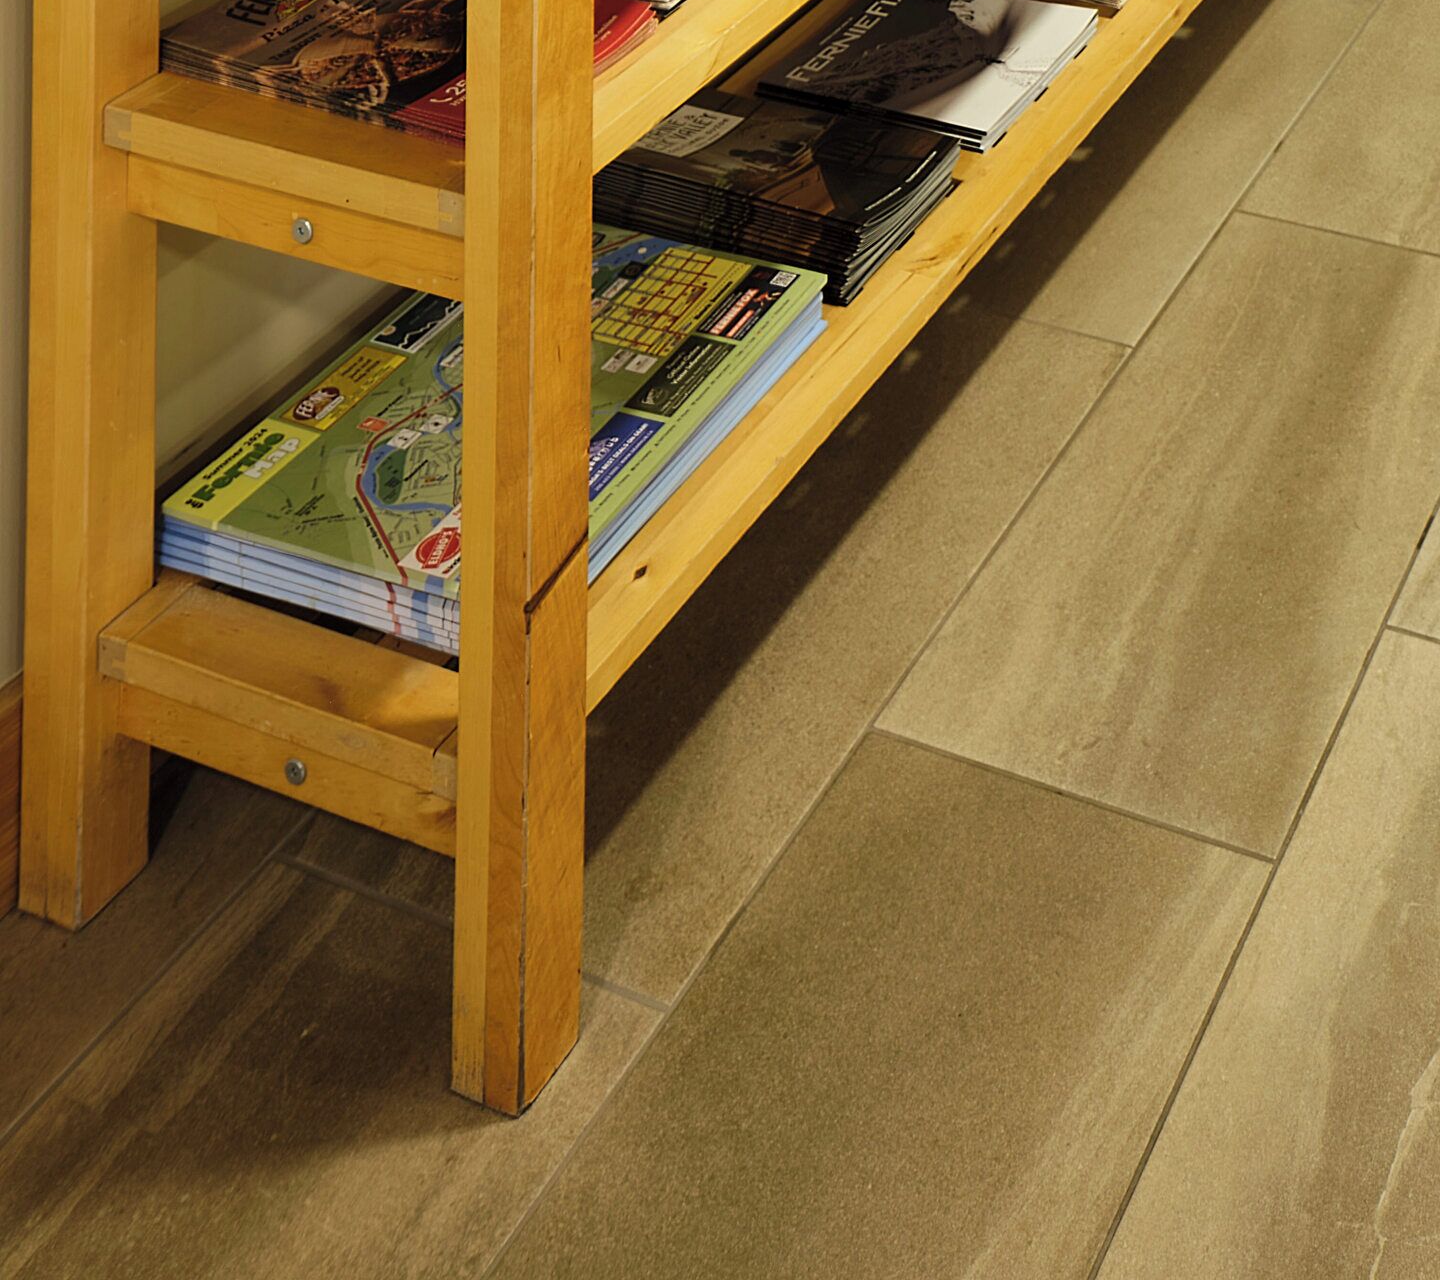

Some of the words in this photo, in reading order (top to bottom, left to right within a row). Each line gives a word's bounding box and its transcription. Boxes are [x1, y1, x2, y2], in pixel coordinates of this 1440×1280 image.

[261, 13, 316, 43] Pizza
[672, 112, 718, 140] VALLEY
[191, 432, 285, 502] Fernie
[202, 441, 244, 481] Summer
[244, 438, 300, 480] Map
